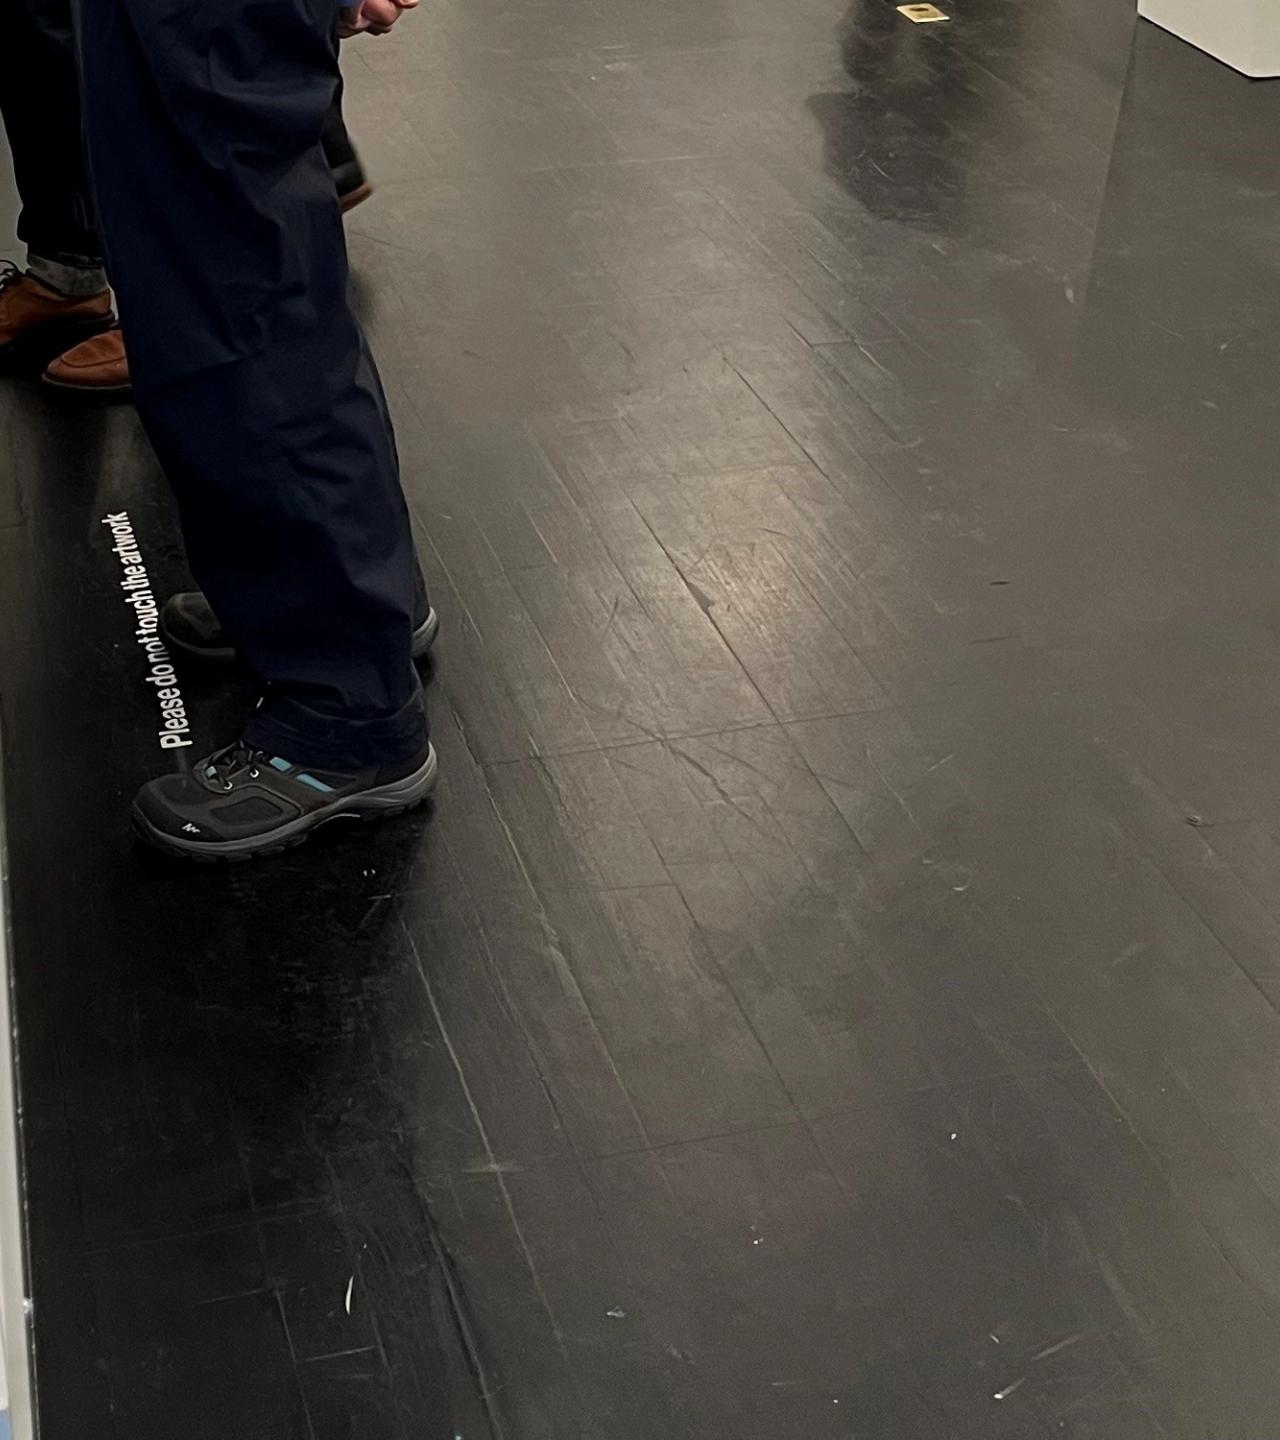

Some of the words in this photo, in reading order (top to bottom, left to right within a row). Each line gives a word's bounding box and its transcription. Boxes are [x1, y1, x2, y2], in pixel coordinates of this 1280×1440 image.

[101, 511, 144, 566] artwork
[120, 565, 150, 591] the
[124, 590, 159, 636] touch
[137, 637, 171, 663] not
[145, 664, 178, 687] do
[157, 687, 193, 749] Please
